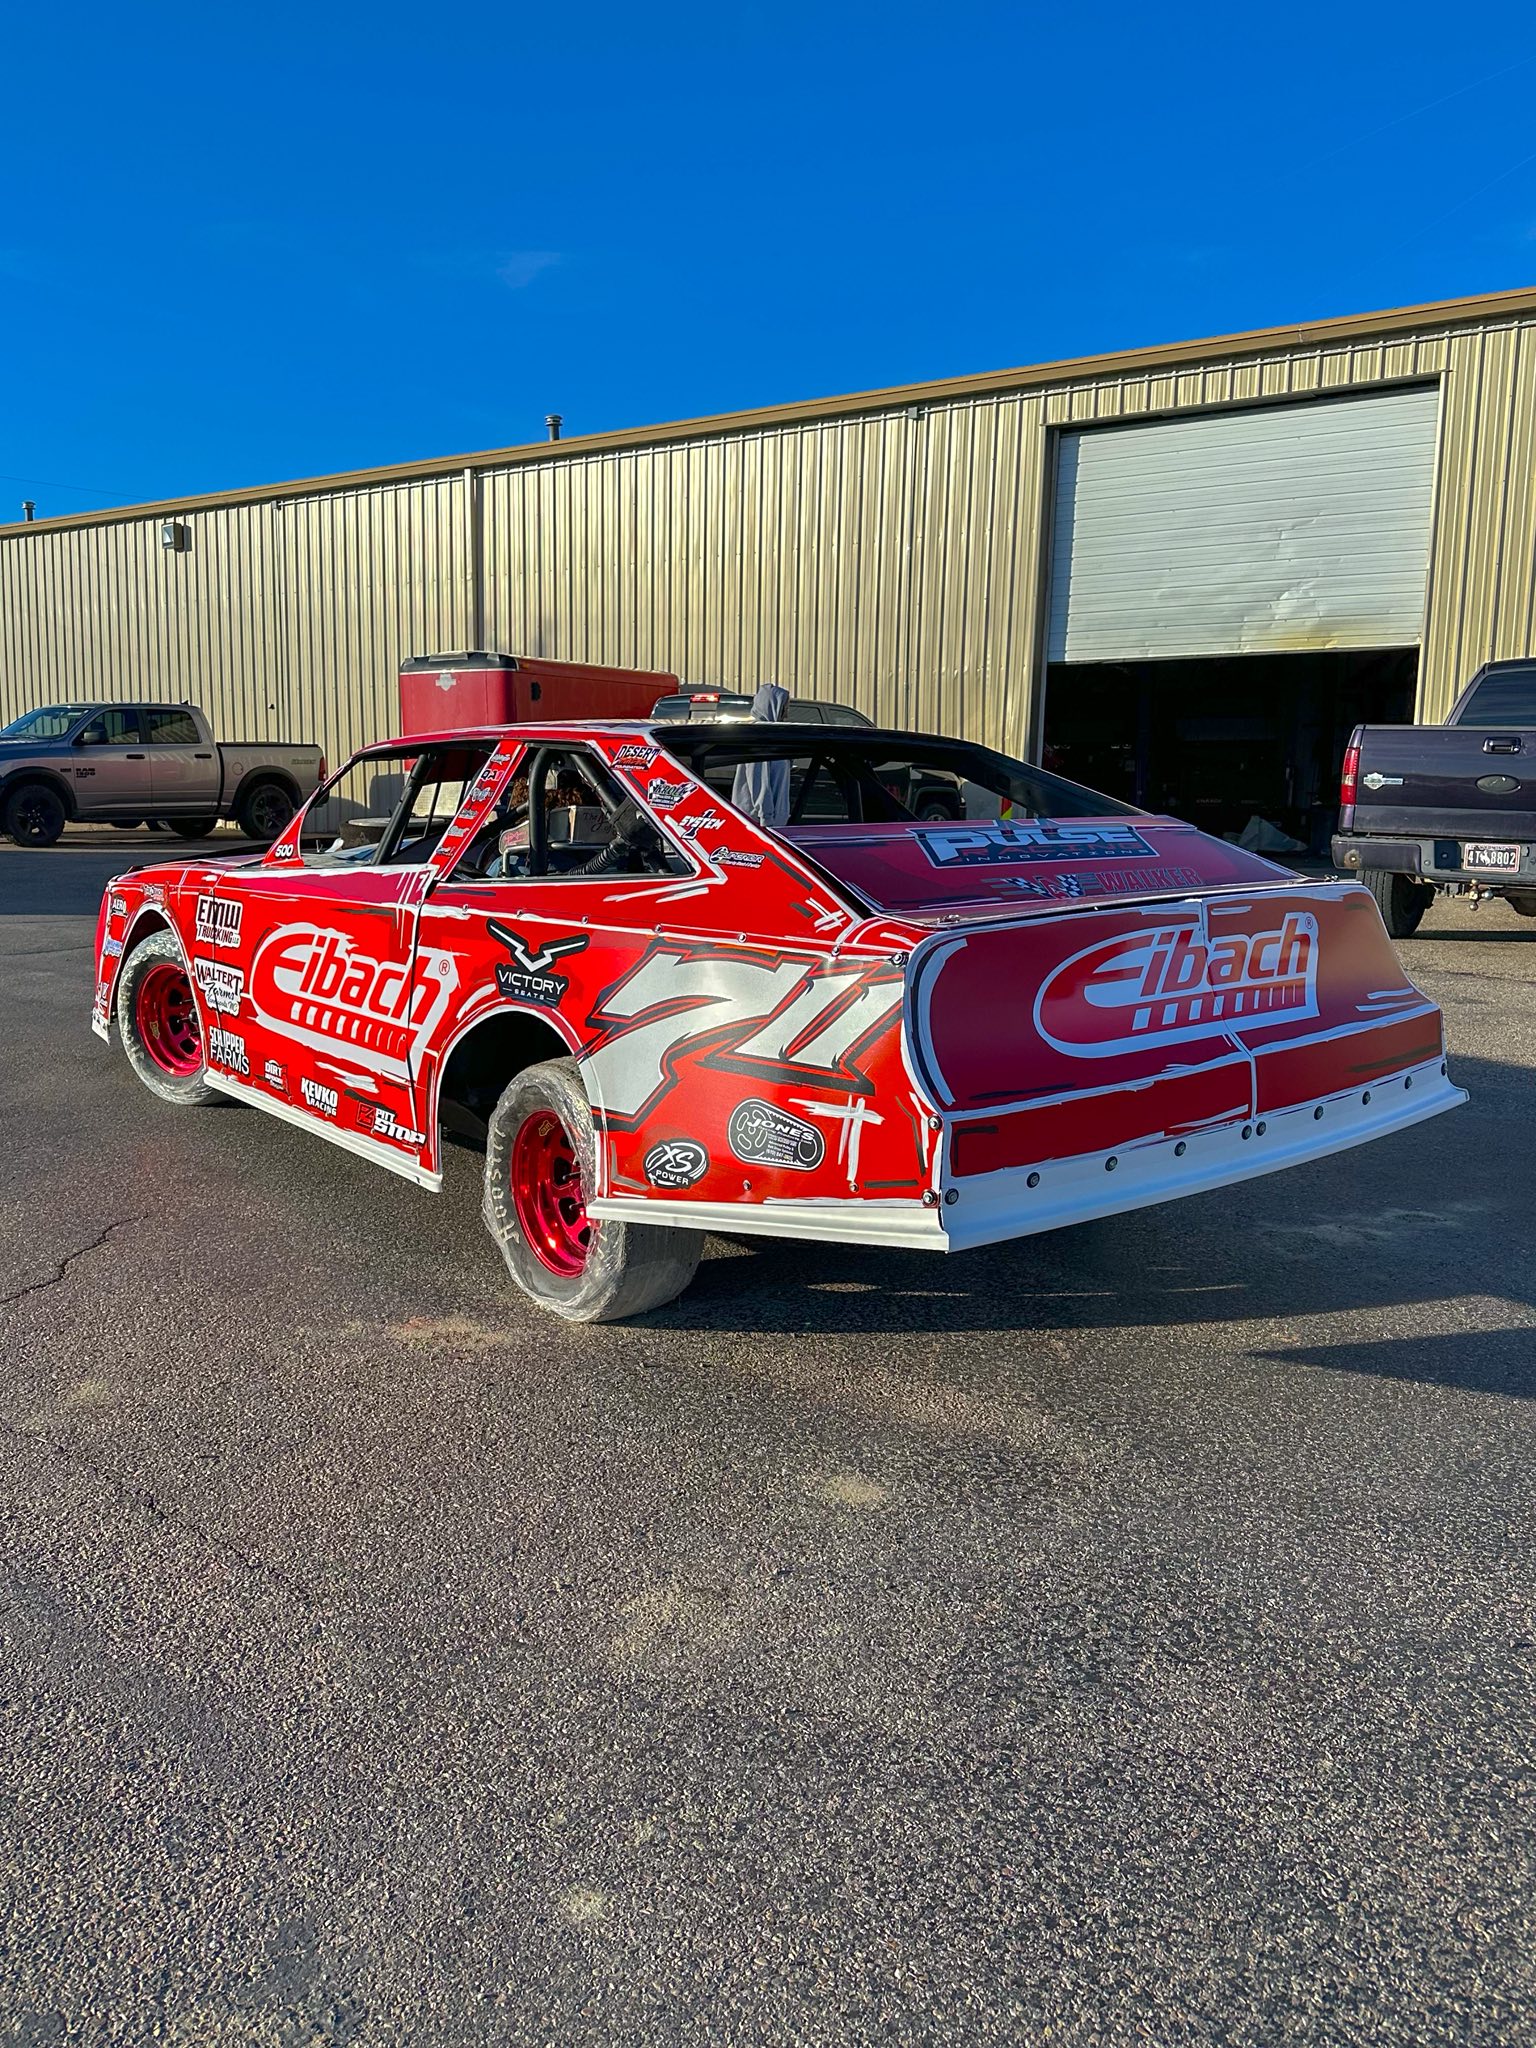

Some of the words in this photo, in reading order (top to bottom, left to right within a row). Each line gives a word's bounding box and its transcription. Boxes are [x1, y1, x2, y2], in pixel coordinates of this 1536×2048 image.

[614, 745, 662, 764] DESERT
[480, 769, 505, 780] QA1
[679, 815, 726, 830] SYSTEM
[275, 844, 293, 857] 500
[925, 825, 1138, 862] PULSE
[962, 842, 1143, 857] RACING
[965, 848, 1149, 862] INNOVATIONS
[1490, 851, 1516, 865] 8802
[1095, 867, 1203, 892] WALKER
[198, 923, 234, 943] TRUCKING
[195, 963, 242, 996] WALTERT
[252, 928, 443, 1050] Eibach
[498, 969, 565, 995] VICTORY
[1038, 918, 1311, 1040] Eibach
[514, 988, 544, 1000] SEATS
[210, 1042, 250, 1075] FARMS
[264, 1061, 283, 1077] DIRT
[300, 1077, 338, 1108] KEVKO
[310, 1097, 337, 1117] RACING
[373, 1119, 427, 1145] STOP
[746, 1118, 815, 1141] JONES
[648, 1144, 695, 1173] XS
[655, 1169, 689, 1185] POWER
